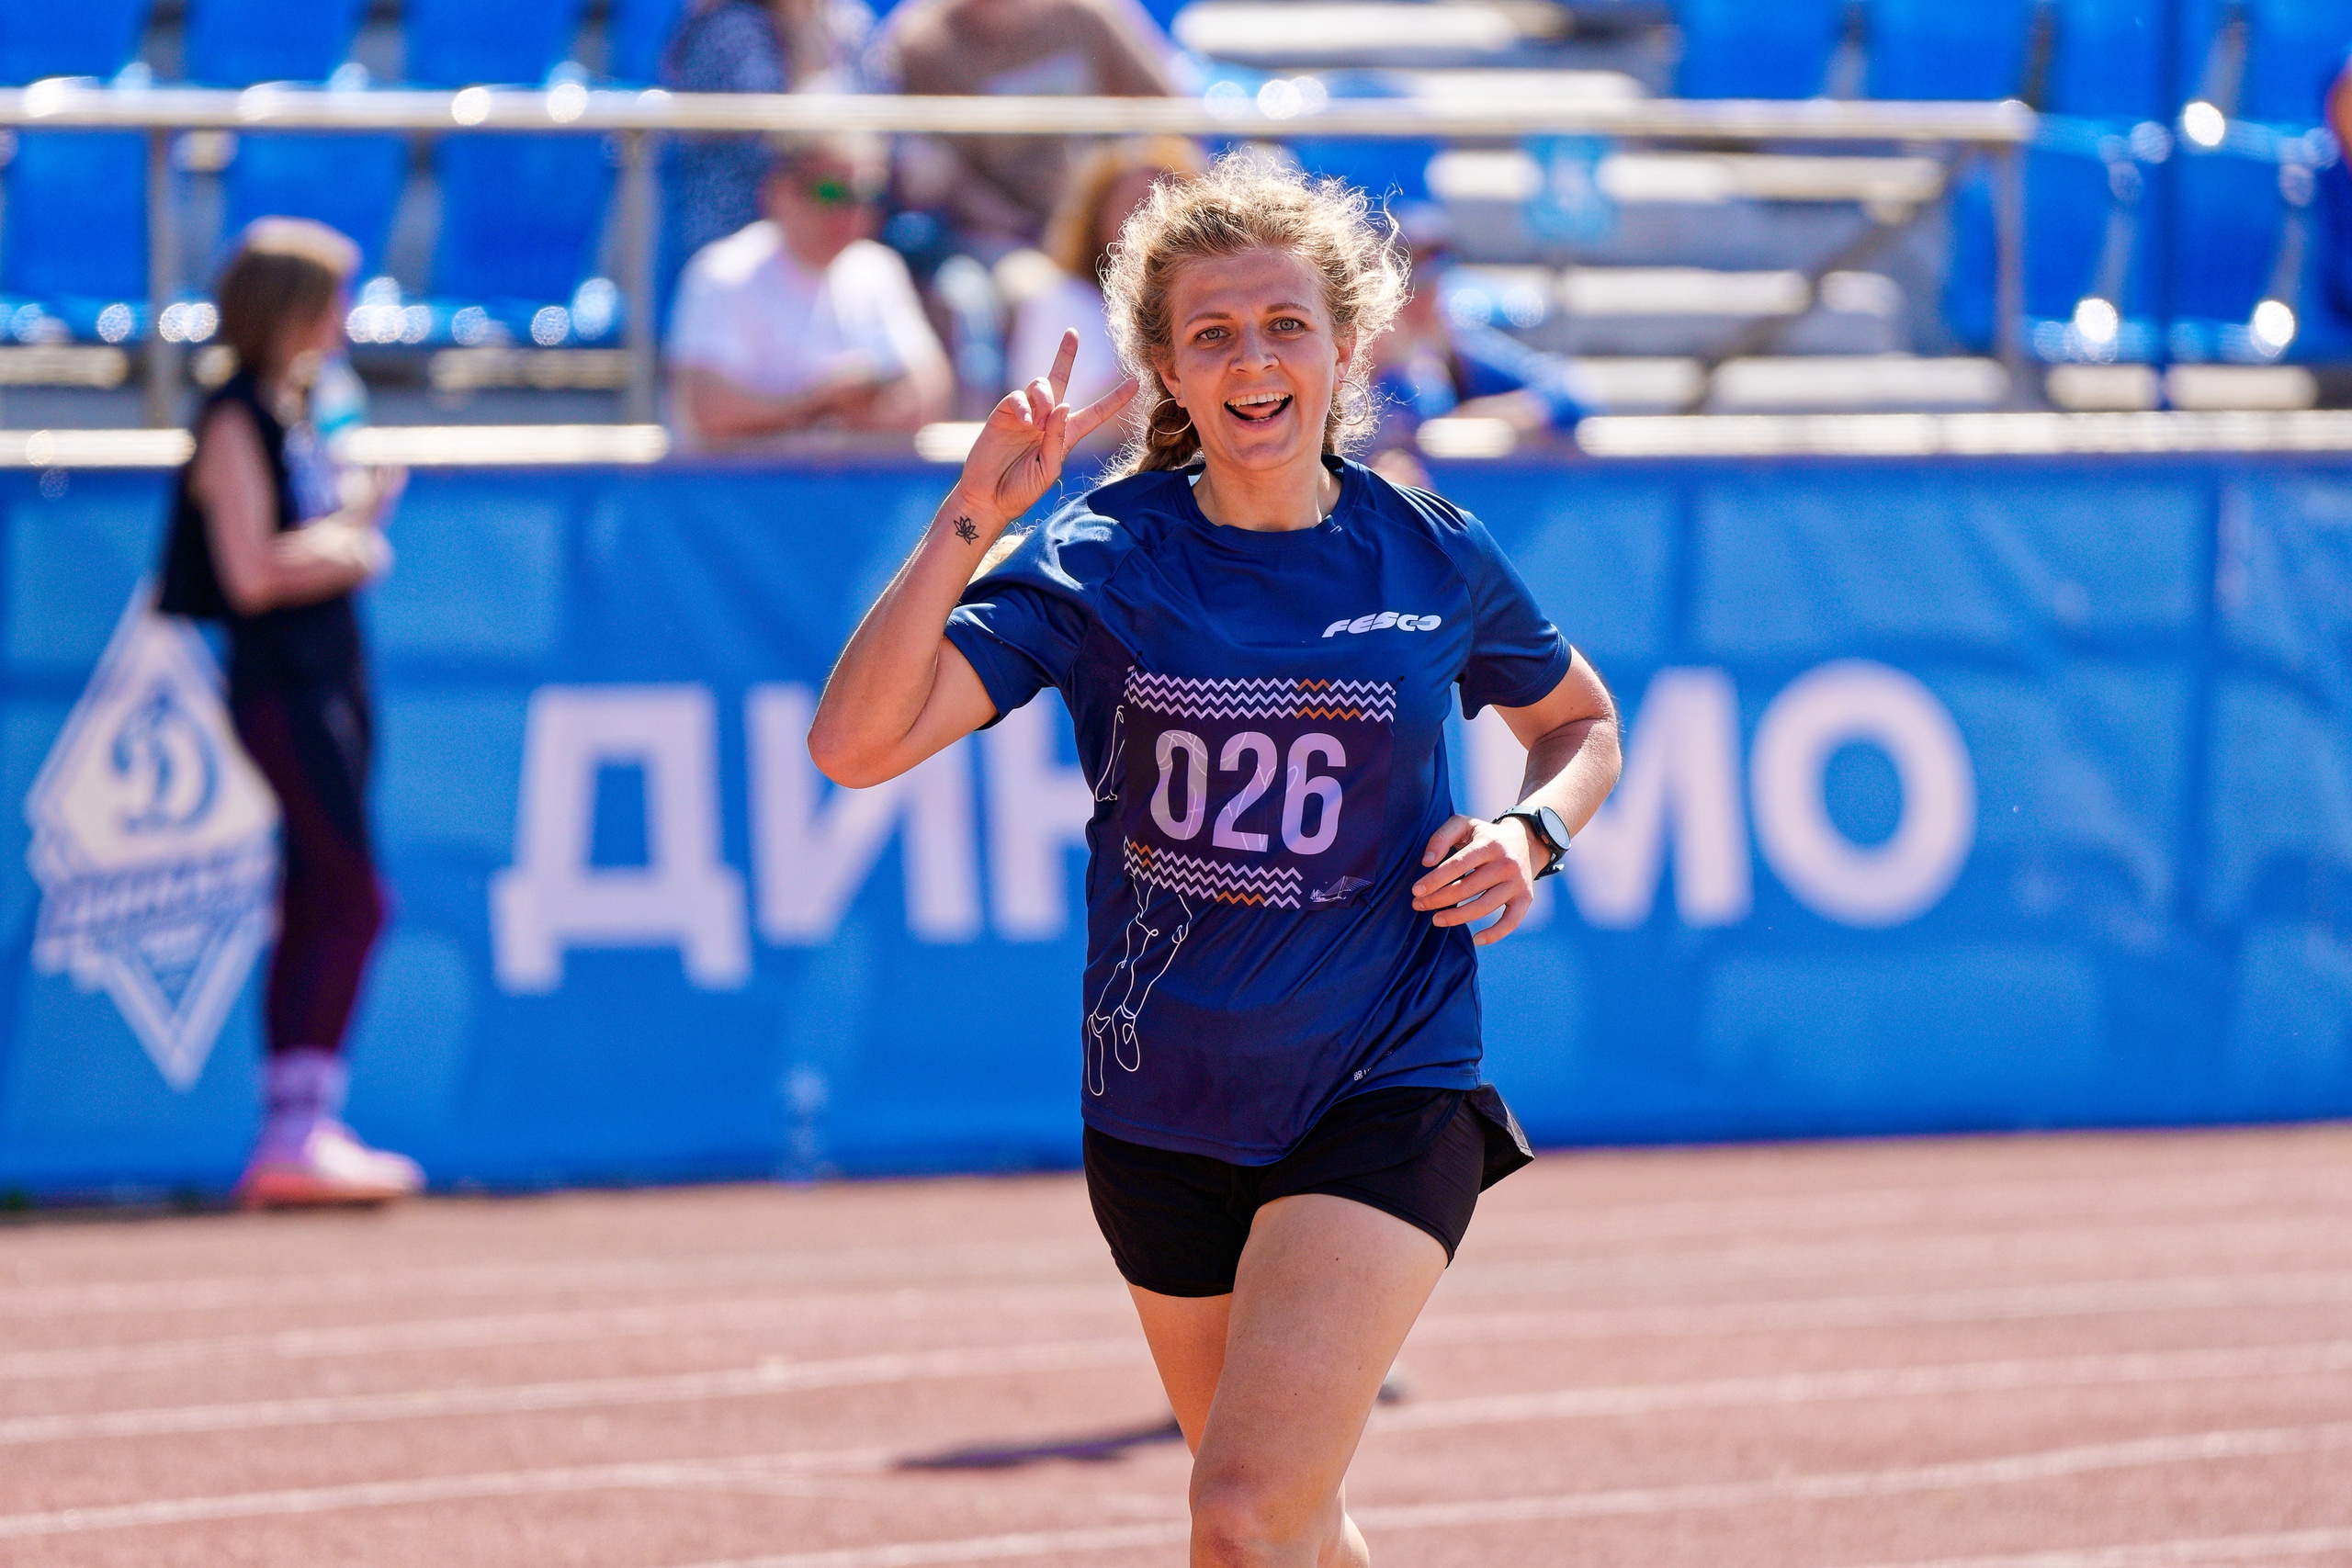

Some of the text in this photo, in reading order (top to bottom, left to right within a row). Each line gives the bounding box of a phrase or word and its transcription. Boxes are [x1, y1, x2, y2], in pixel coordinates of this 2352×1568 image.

[1321, 611, 1442, 638] FESCO
[489, 660, 1975, 994] ДИНМО
[1150, 730, 1347, 855] 026
